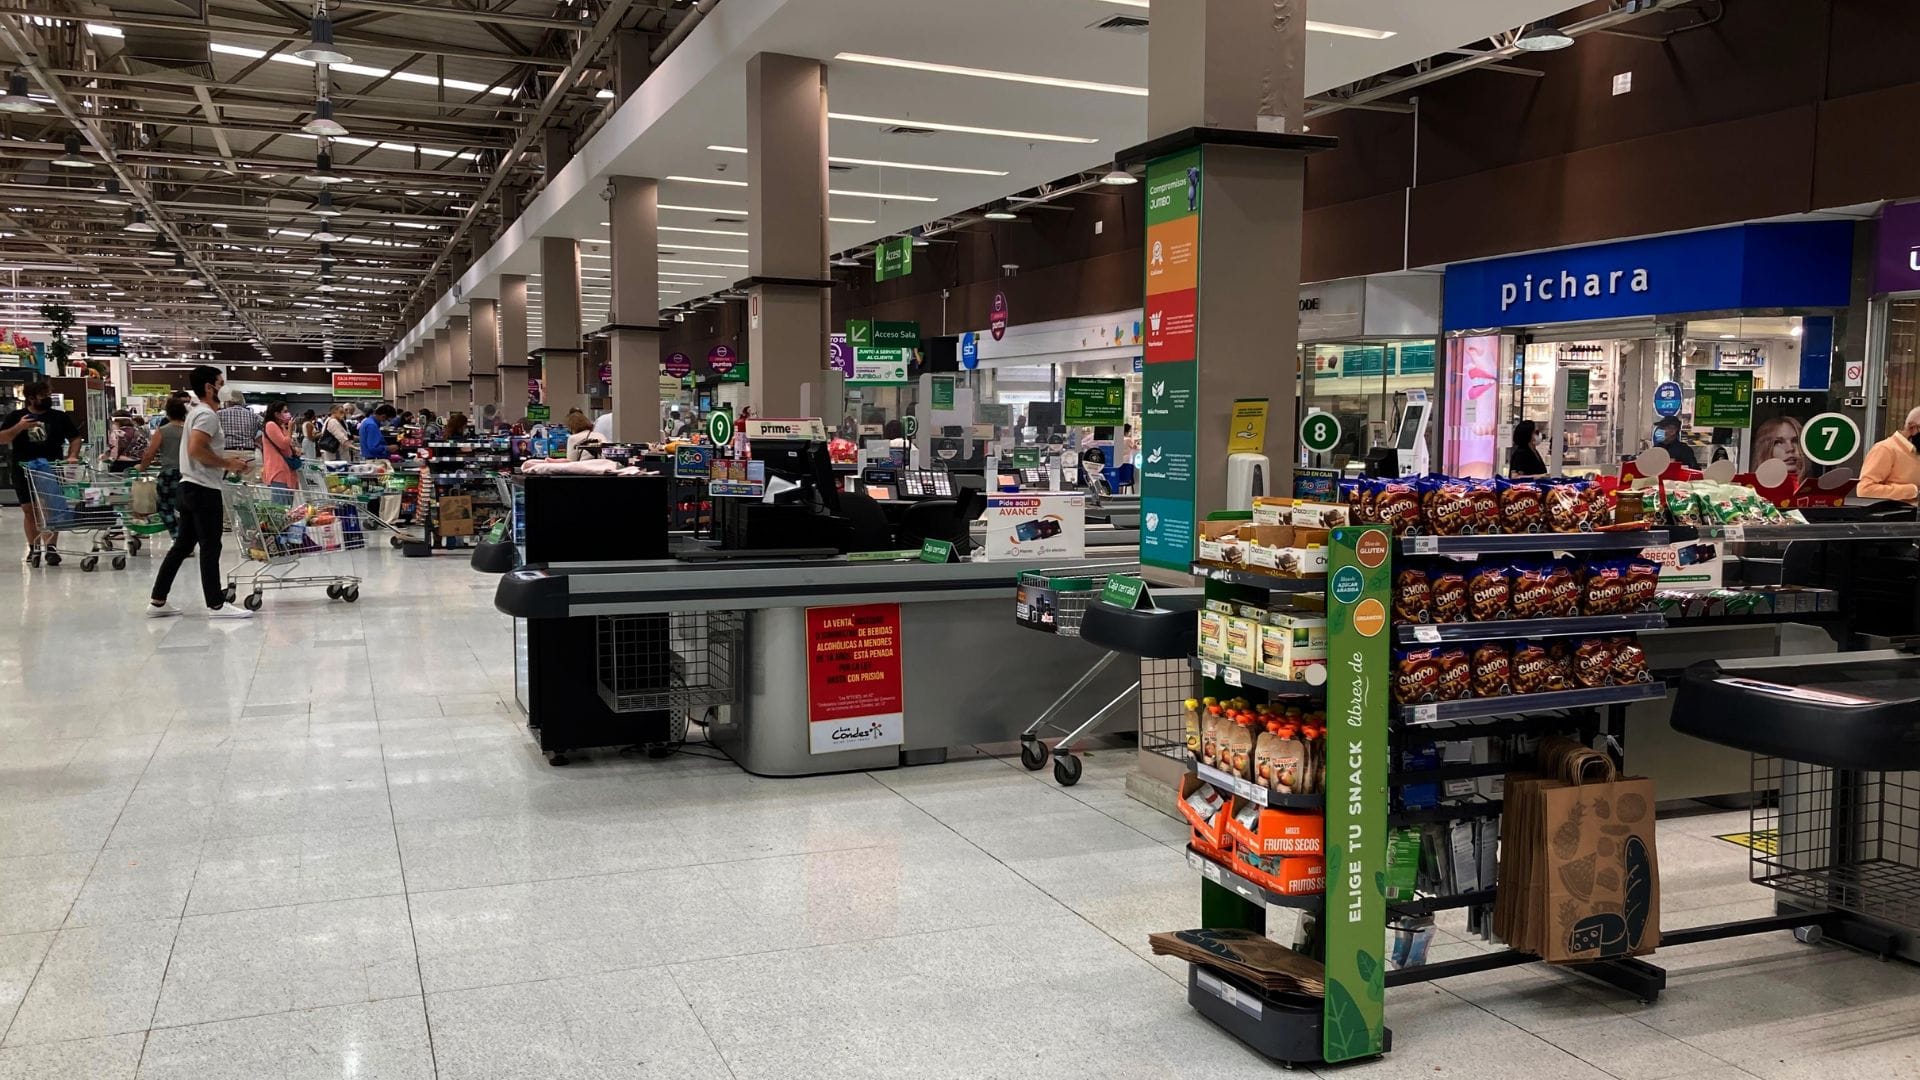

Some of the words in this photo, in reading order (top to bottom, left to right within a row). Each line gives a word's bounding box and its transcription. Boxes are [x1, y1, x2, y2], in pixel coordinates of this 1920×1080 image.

[1149, 178, 1187, 195] Compromisos
[1149, 195, 1171, 210] JUMBO
[1501, 268, 1649, 311] pichara
[101, 327, 117, 336] 16b
[874, 330, 899, 338] Acceso
[899, 330, 916, 339] Sala
[1756, 394, 1812, 406] pichara
[717, 421, 724, 437] 9
[760, 424, 791, 435] prime
[1314, 422, 1327, 442] 8
[1820, 426, 1840, 451] 7
[999, 508, 1039, 516] AVANCE
[1380, 500, 1413, 520] CHOCO
[1436, 499, 1472, 517] CHOCO
[1504, 498, 1535, 516] CHOCO
[1359, 547, 1385, 555] GLUTEN
[1645, 551, 1677, 561] PRECIO
[1107, 579, 1119, 592] Caja
[1118, 582, 1138, 596] cerrada
[1402, 583, 1429, 598] CHOCO
[1513, 587, 1548, 604] CHOCO
[1589, 585, 1621, 601] CHOCO
[823, 618, 832, 629] LA
[858, 628, 867, 637] DE
[867, 625, 893, 636] BEBIDAS
[816, 638, 858, 652] ALCOHÓLICAS
[858, 639, 863, 648] A
[863, 637, 892, 648] MENORES
[869, 648, 894, 658] PENADA
[1580, 650, 1608, 670] CHOCO
[1347, 651, 1363, 673] de
[1477, 658, 1508, 677] CHOCO
[847, 673, 860, 683] CON
[860, 670, 885, 682] PRISIÓN
[1400, 667, 1433, 686] CHOCO
[1439, 664, 1469, 684] CHOCO
[1347, 675, 1363, 727] libres
[831, 726, 869, 740] Condes
[1349, 739, 1362, 816] SNACK
[1263, 838, 1293, 851] FRUTOS
[1294, 838, 1320, 851] SECOS
[1349, 824, 1362, 853] TU
[1288, 878, 1316, 893] FRUTOS
[1349, 860, 1362, 923] ELIGE
